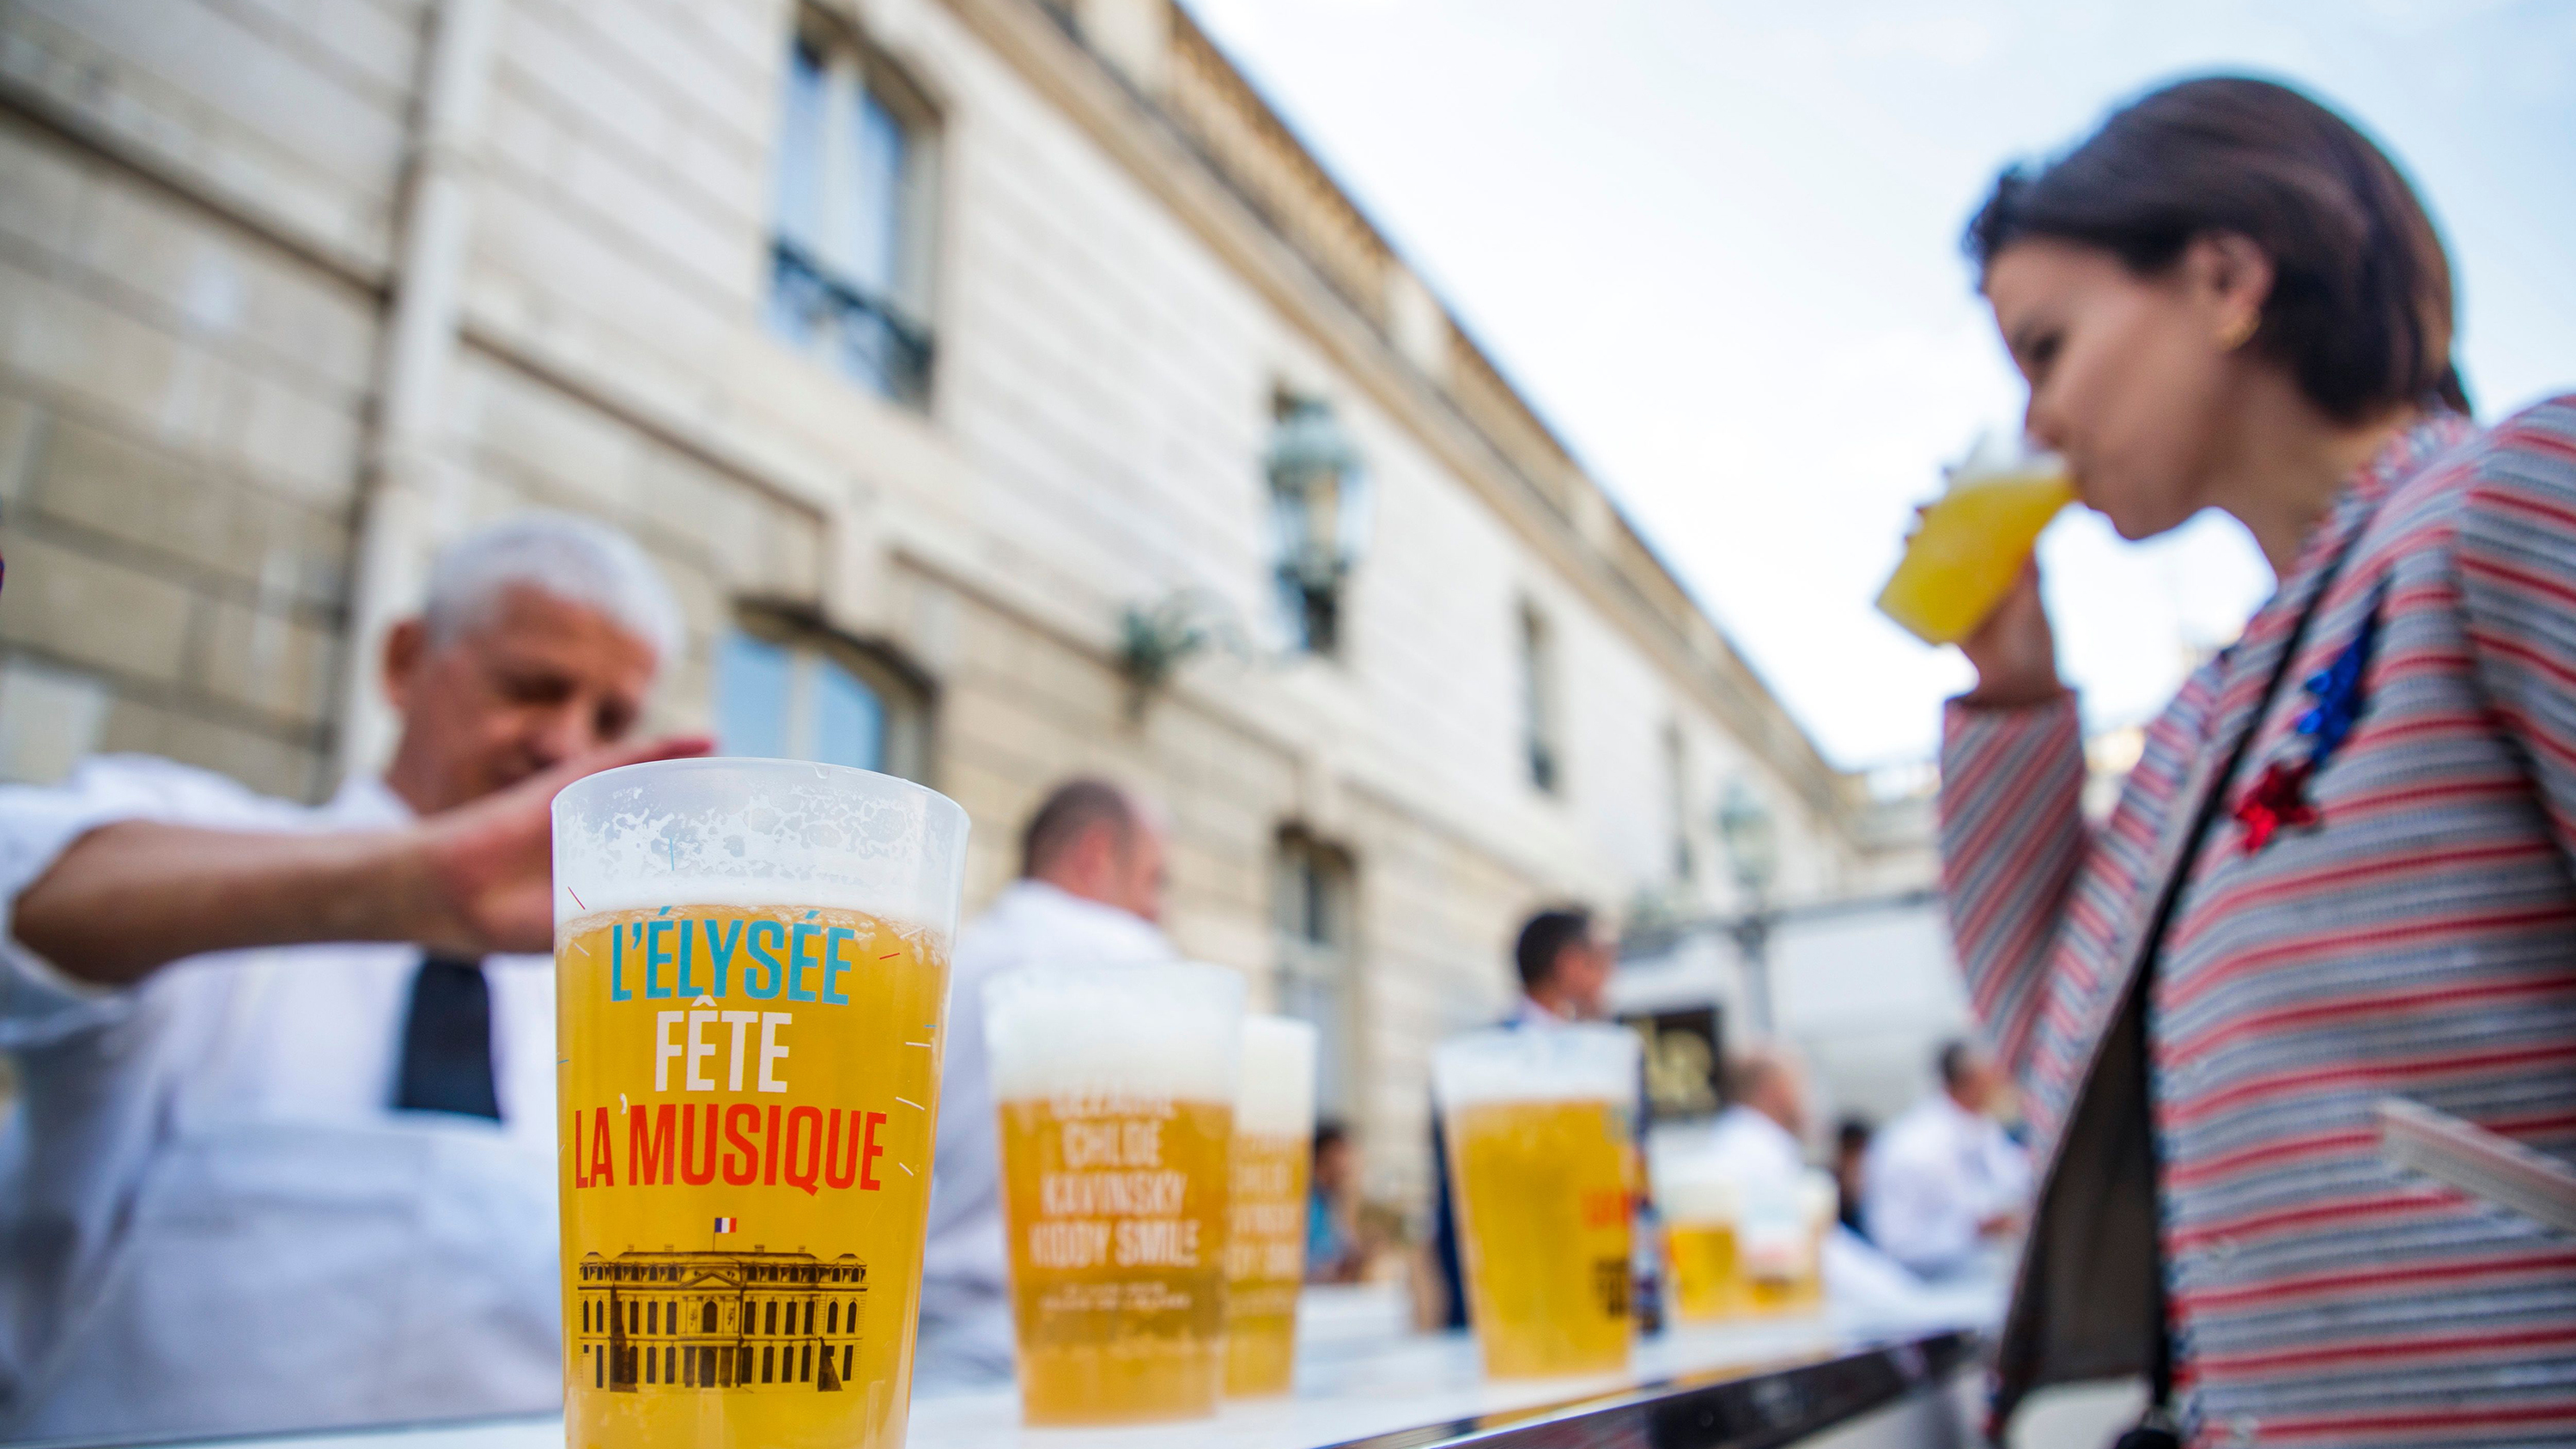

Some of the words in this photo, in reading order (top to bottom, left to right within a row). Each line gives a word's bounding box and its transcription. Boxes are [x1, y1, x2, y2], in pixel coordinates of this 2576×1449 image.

[611, 905, 855, 1006] L'ÉLYSÉE
[655, 995, 793, 1093] FÊTE
[575, 1106, 615, 1190] LA
[628, 1104, 887, 1196] MUSIQUE
[1115, 1219, 1201, 1268] SMILE
